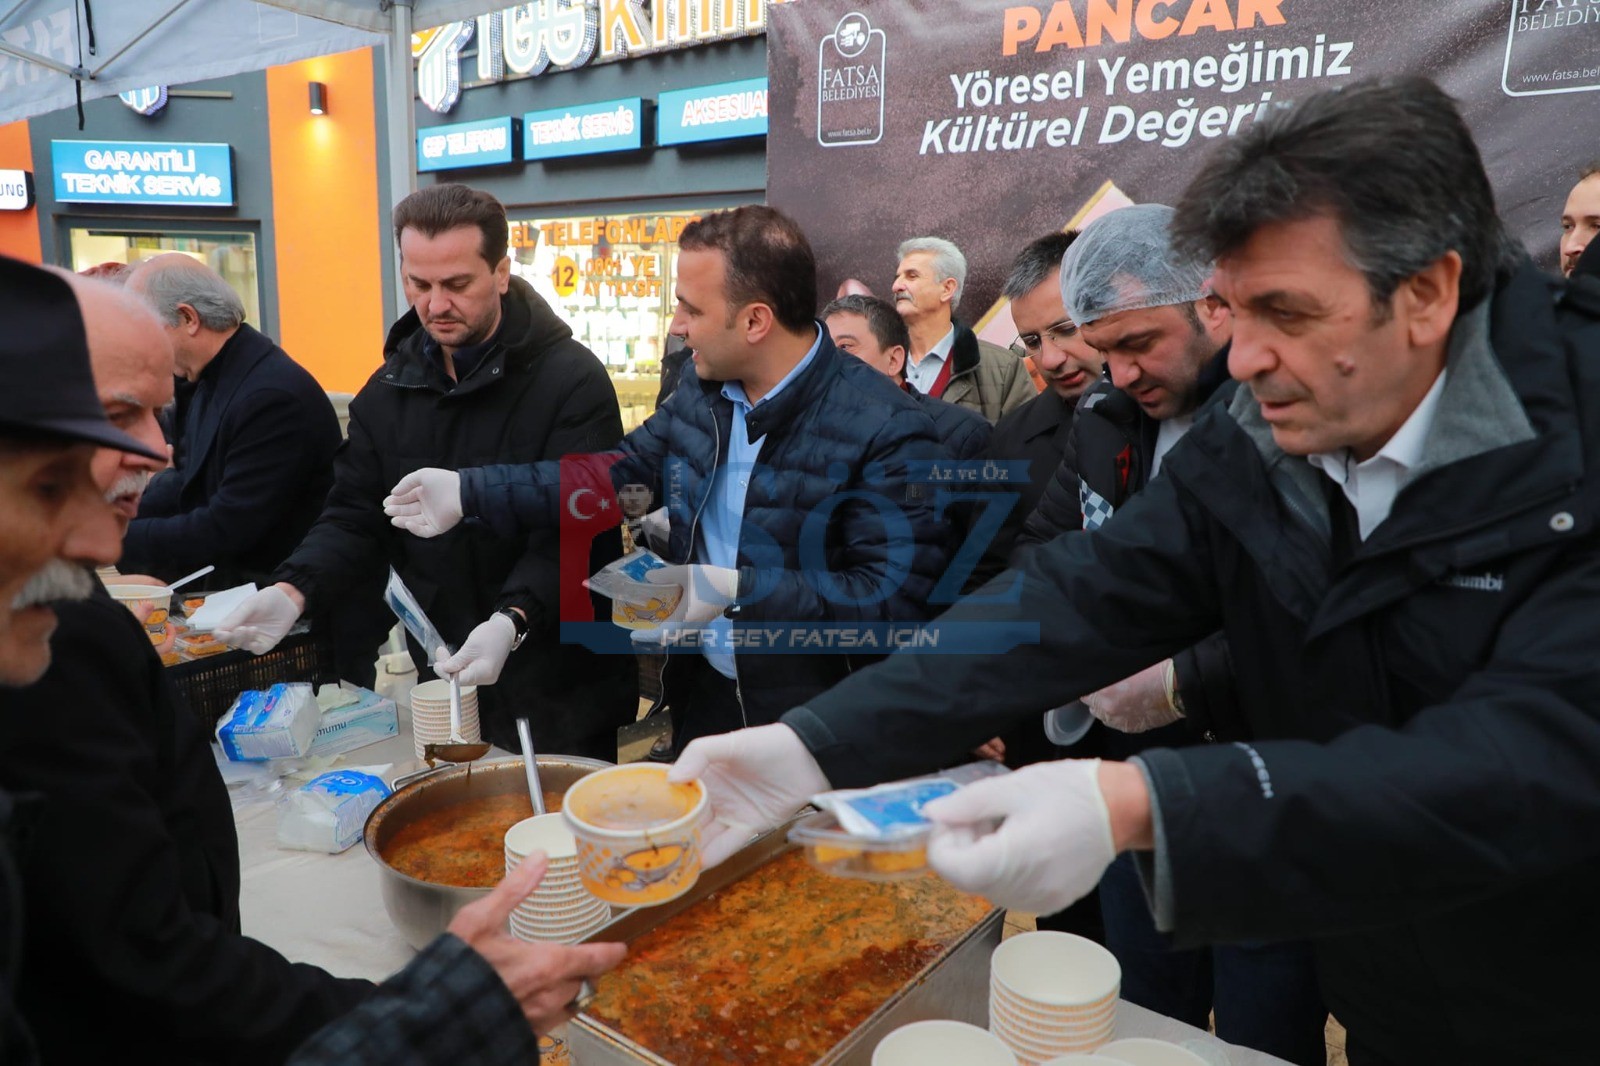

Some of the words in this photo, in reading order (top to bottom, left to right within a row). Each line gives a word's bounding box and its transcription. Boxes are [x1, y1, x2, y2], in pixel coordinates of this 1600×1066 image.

[1003, 0, 1287, 56] PANCAR
[823, 64, 880, 89] FATSA
[950, 60, 1085, 108] Yöresel
[1097, 33, 1354, 97] Yemeğimiz
[822, 83, 880, 102] BELEDİYESİ
[530, 113, 581, 146] TEKNİK
[581, 105, 634, 138] SERVİS
[827, 127, 873, 138] www.fatsa.bel.tr
[919, 107, 1090, 155] Kültürel
[1098, 91, 1294, 149] Değeri
[423, 135, 446, 159] CEP
[447, 127, 506, 155] TELEFONU
[84, 149, 196, 172] GARANTİLİ
[62, 171, 141, 194] TEKNİK
[143, 173, 221, 197] SERVİS
[511, 225, 536, 248] EL
[541, 215, 703, 246] TELEFONLAR
[552, 265, 574, 288] 12
[583, 280, 600, 297] AY
[605, 277, 663, 297] TAKSİT
